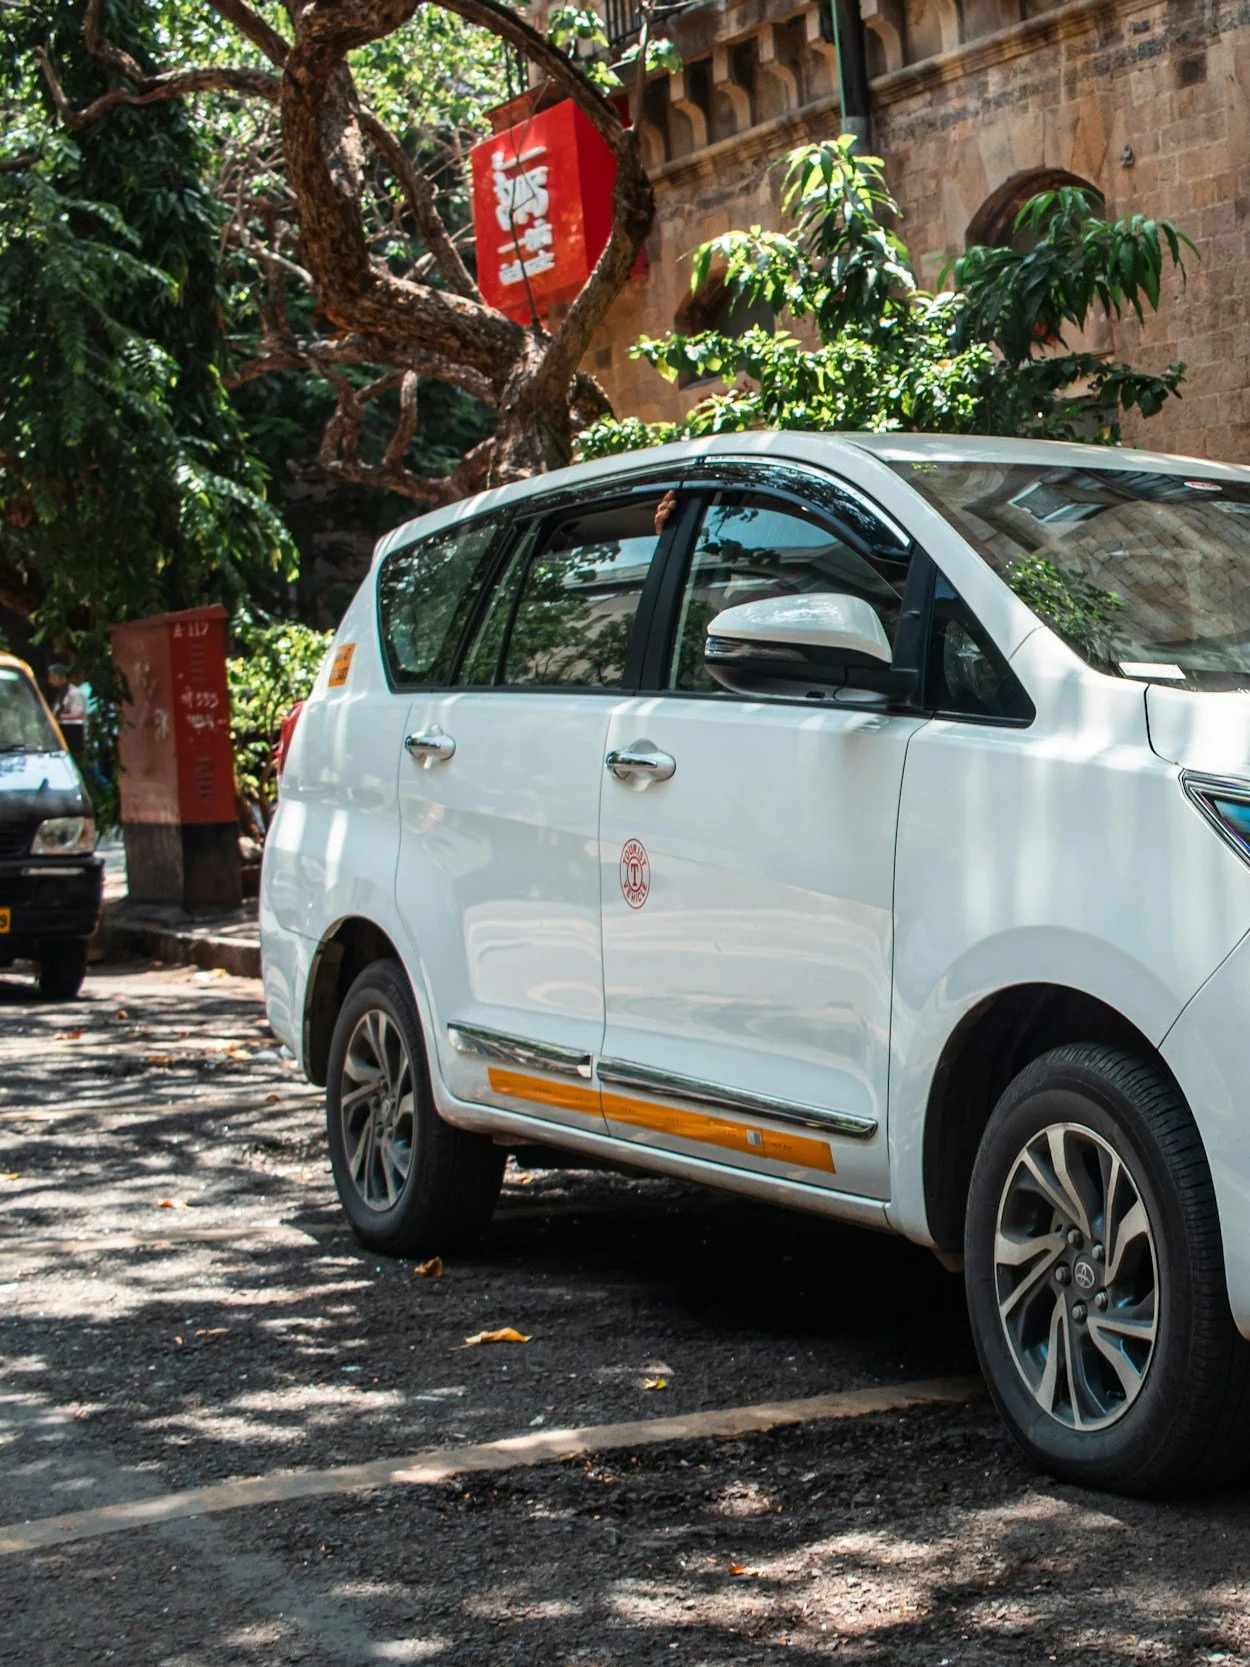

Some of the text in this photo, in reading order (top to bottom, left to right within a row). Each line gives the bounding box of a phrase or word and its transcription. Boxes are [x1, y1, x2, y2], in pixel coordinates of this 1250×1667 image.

[622, 843, 647, 867] TOURIST
[630, 863, 639, 887] T
[623, 879, 648, 904] VEHICLE
